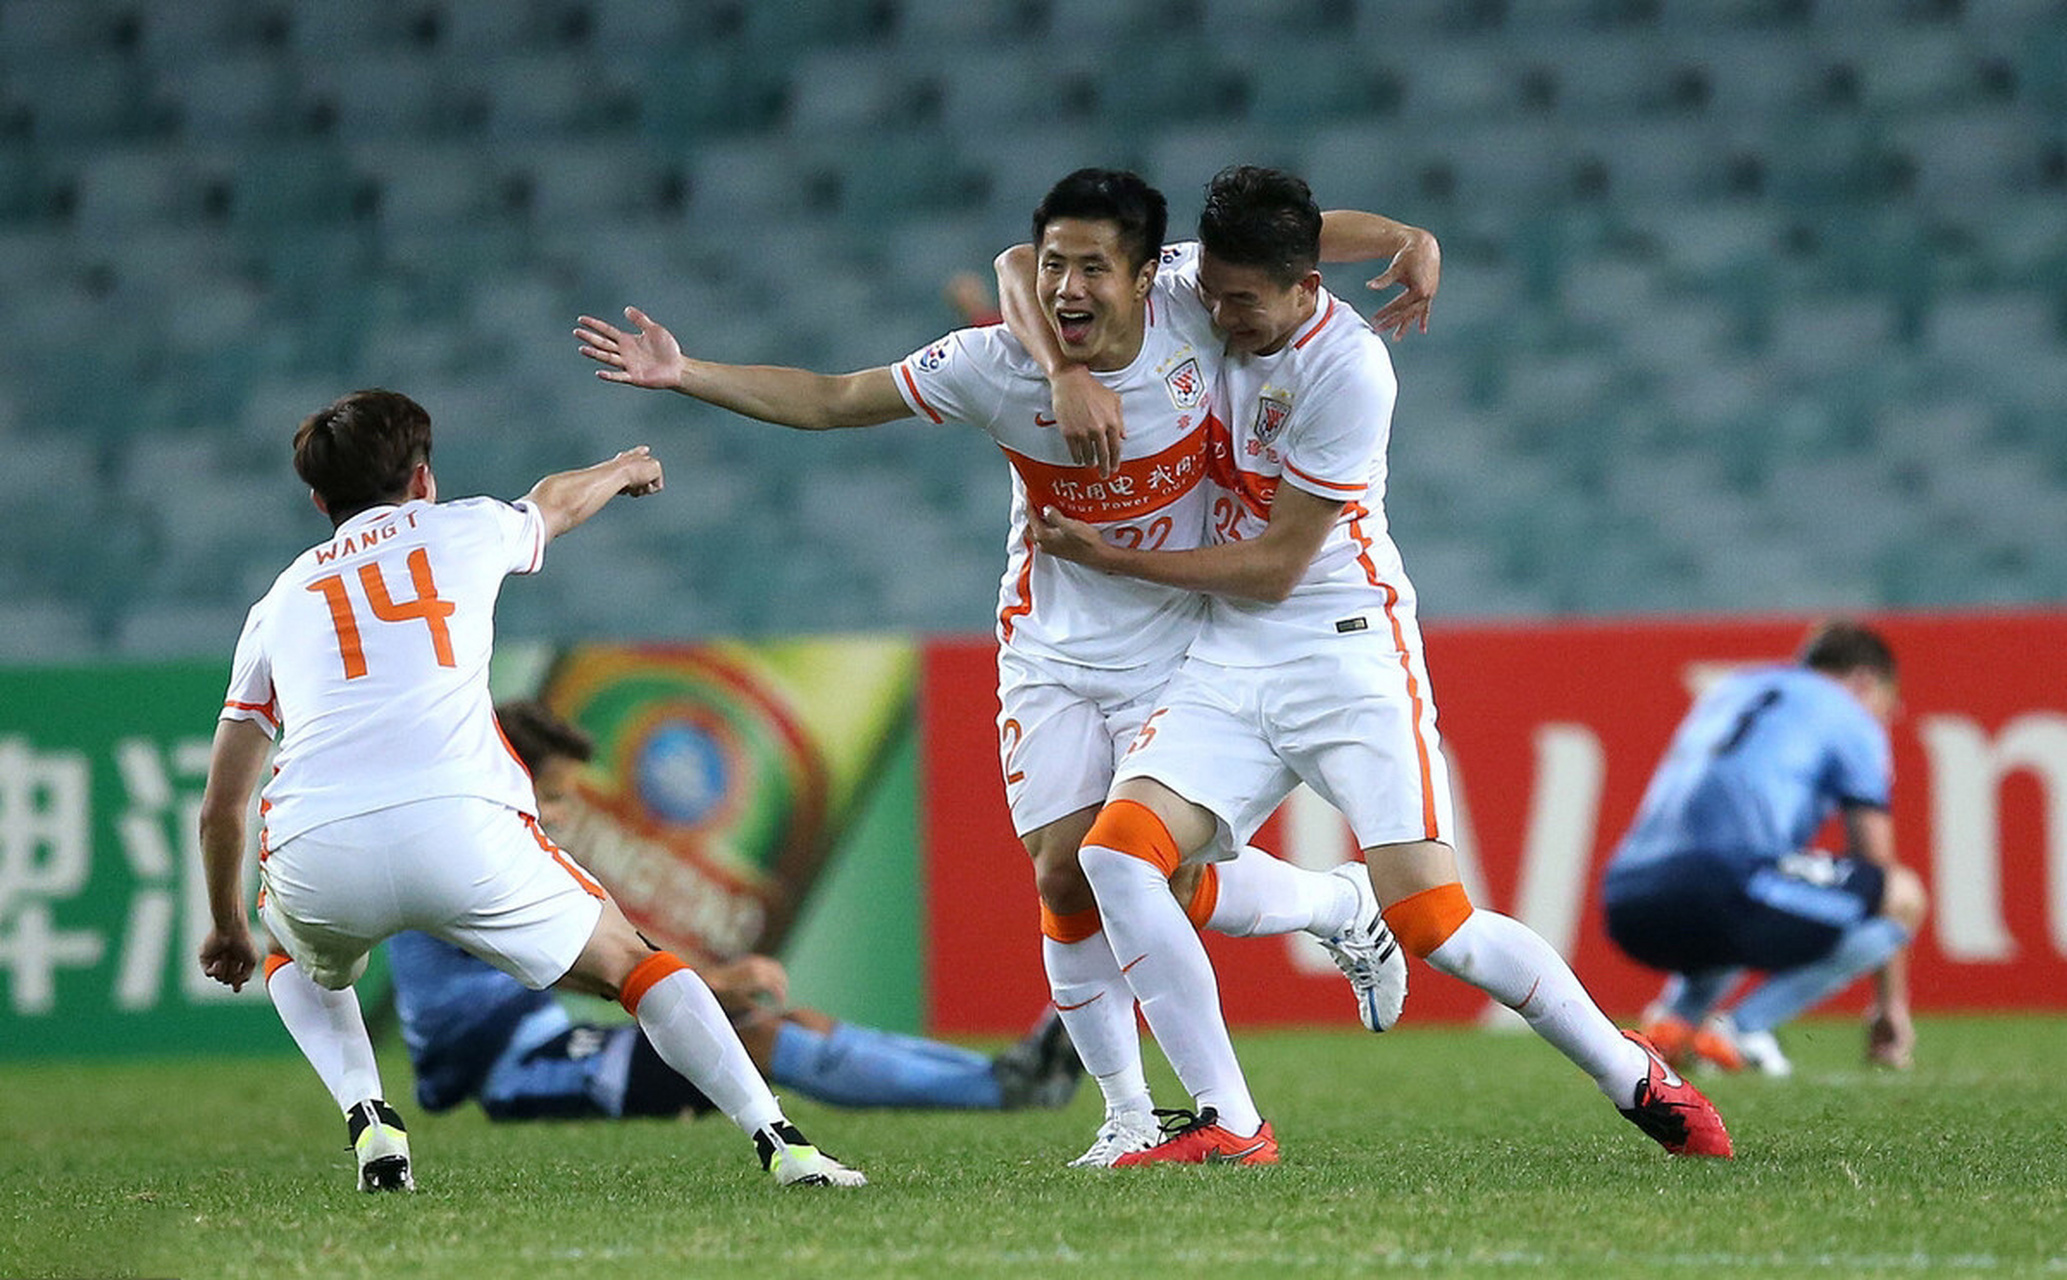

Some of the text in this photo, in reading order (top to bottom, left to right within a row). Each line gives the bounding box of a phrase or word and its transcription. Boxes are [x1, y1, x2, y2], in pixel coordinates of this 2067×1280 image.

[316, 509, 419, 565] WANG T
[306, 548, 456, 679] 14
